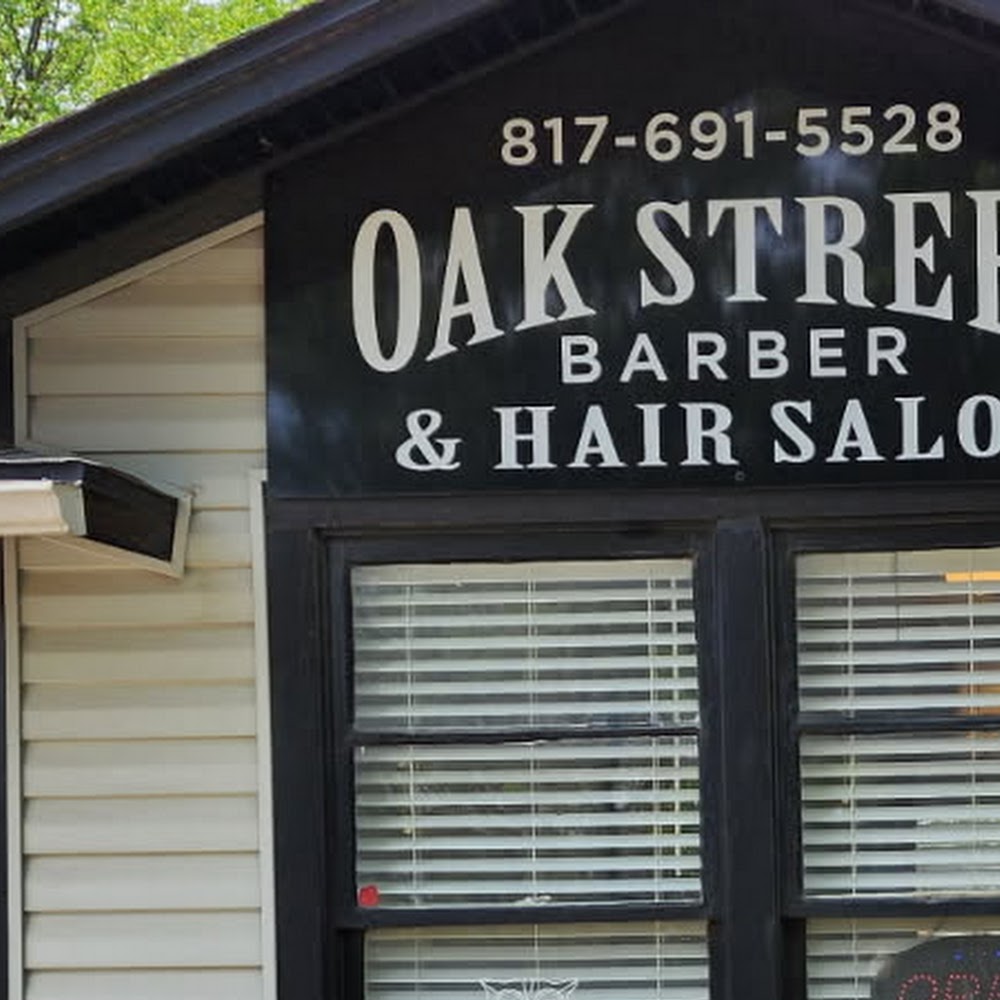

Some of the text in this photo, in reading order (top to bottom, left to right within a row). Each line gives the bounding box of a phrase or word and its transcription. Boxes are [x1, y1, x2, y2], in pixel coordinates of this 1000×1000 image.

[501, 102, 962, 166] 817-691-5528
[351, 203, 597, 373] OAK
[561, 326, 908, 384] BARBER
[395, 409, 462, 471] &
[493, 402, 739, 470] HAIR
